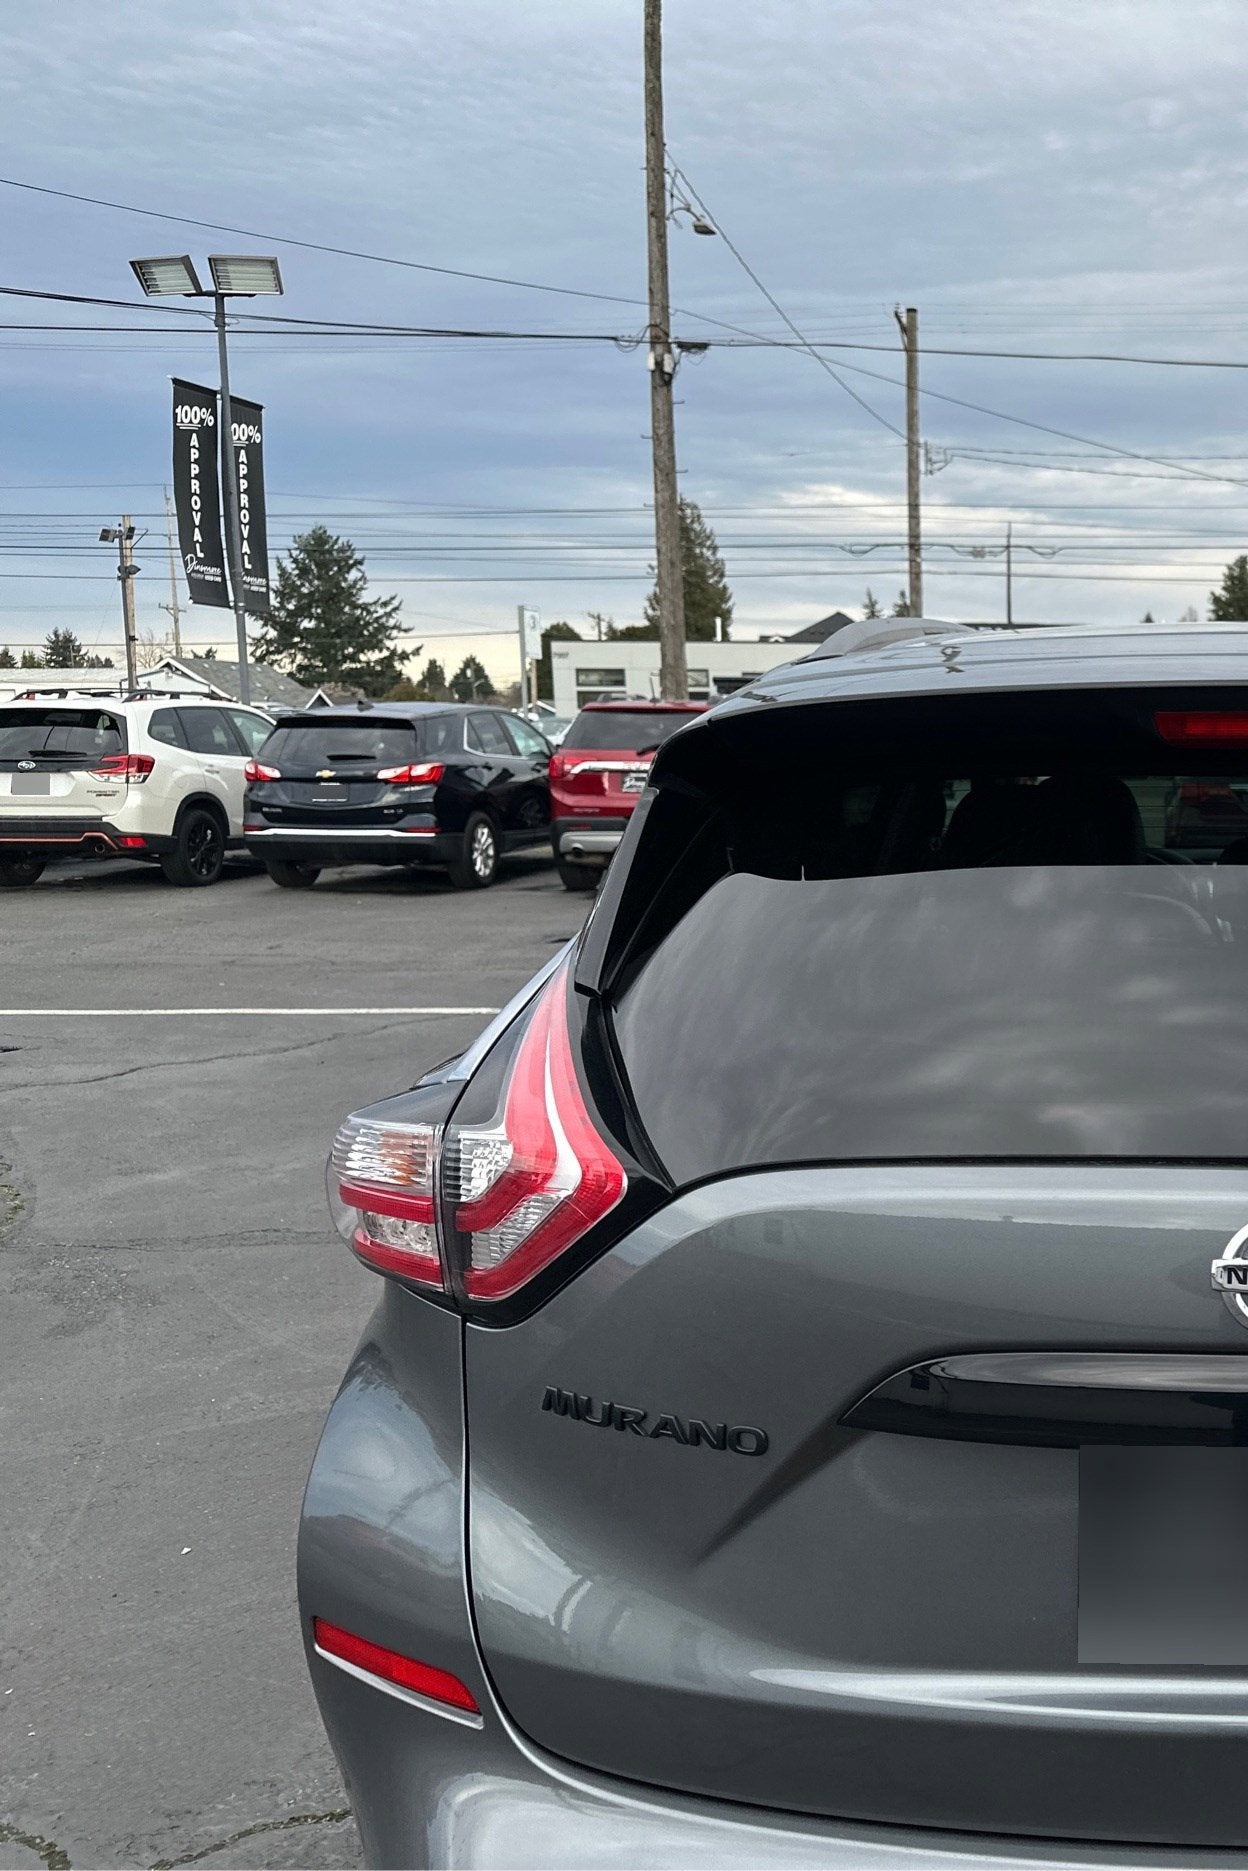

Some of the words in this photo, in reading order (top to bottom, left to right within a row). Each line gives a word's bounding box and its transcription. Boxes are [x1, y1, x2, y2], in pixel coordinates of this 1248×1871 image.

[175, 405, 214, 427] 100%
[230, 422, 262, 444] 00%
[189, 432, 205, 558] APPROVAL
[238, 449, 252, 569] APPROVAL
[541, 1385, 770, 1457] MURANO
